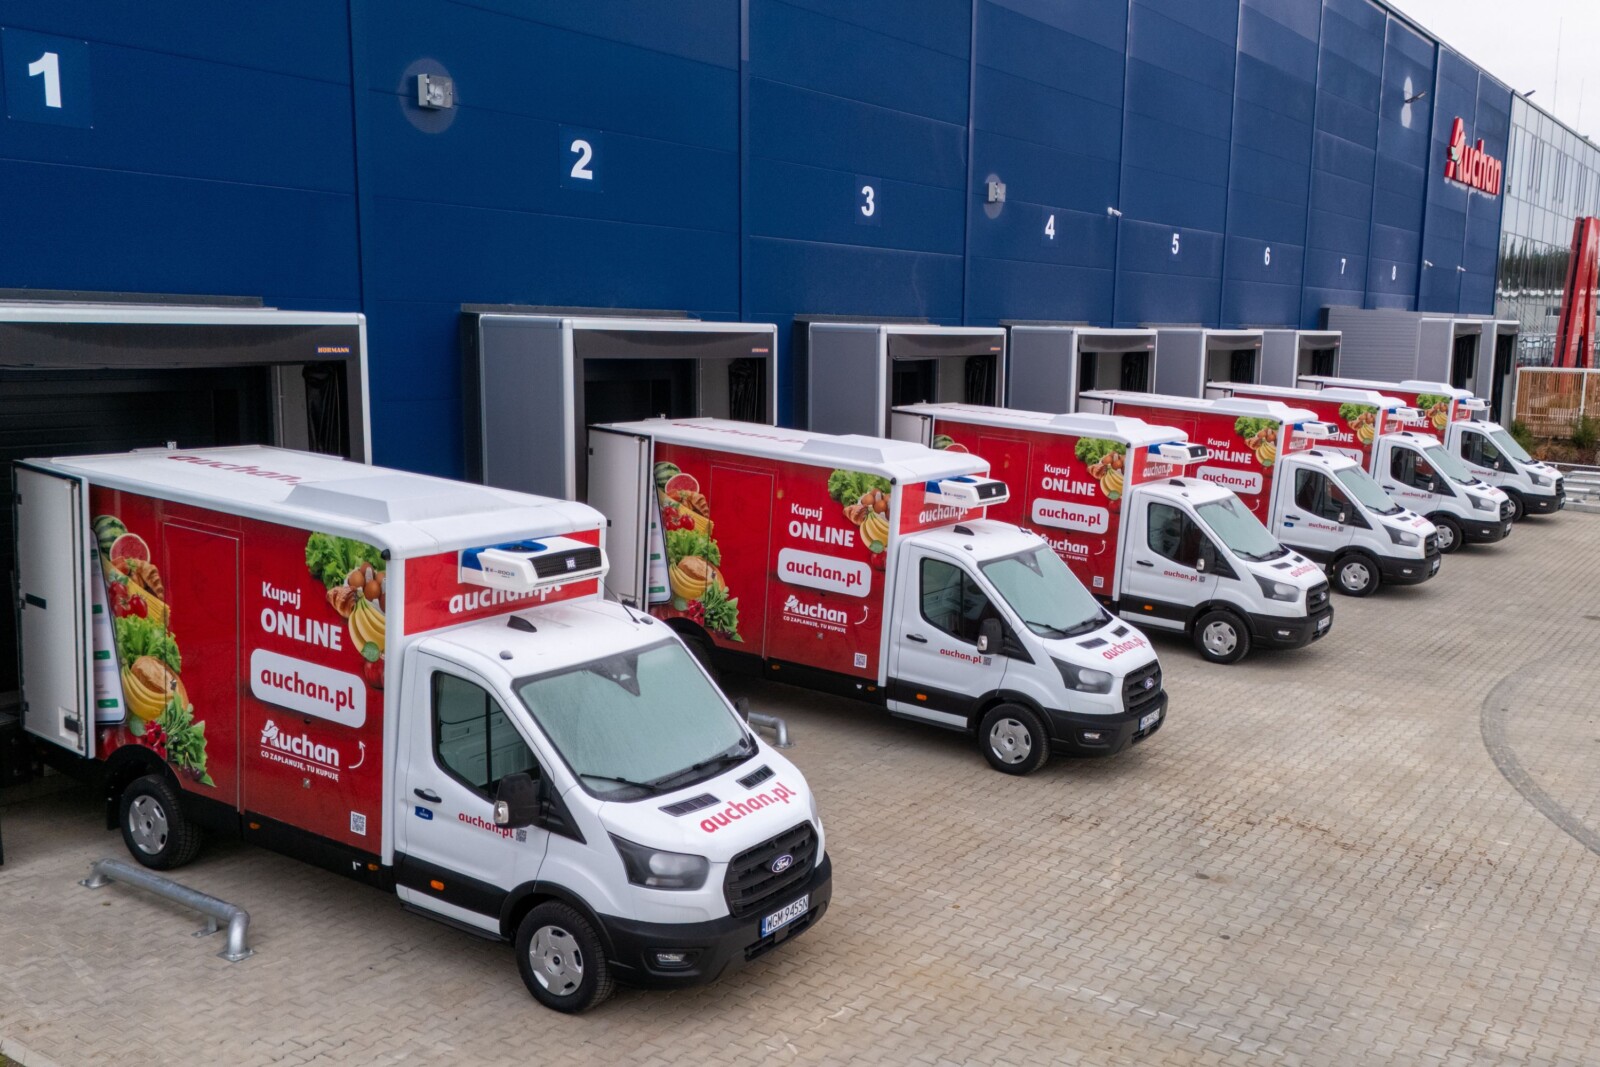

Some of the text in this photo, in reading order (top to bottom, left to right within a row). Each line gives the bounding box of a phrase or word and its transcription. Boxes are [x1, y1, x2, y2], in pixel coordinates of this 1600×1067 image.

[29, 52, 62, 108] 1
[570, 139, 593, 180] 2
[1444, 116, 1501, 195] Auchan
[861, 185, 875, 217] 3
[1045, 214, 1055, 240] 4
[1172, 233, 1180, 255] 5
[1264, 246, 1271, 266] 6
[1341, 258, 1346, 275] 7
[1207, 437, 1230, 449] Kupuj
[1207, 448, 1253, 464] ONLINE
[1043, 463, 1070, 477] Kupuj
[1202, 473, 1256, 488] auchan.pl
[1041, 477, 1096, 497] ONLINE
[791, 502, 823, 521] Kupuj
[1039, 508, 1101, 526] auchan.pl
[788, 520, 855, 547] ONLINE
[786, 561, 862, 587] auchan.pl
[262, 581, 301, 610] Kupuj
[783, 594, 848, 624] Auchan
[261, 607, 343, 652] ONLINE
[940, 648, 982, 664] auchan.pl
[261, 669, 355, 712] auchan.pl
[261, 719, 340, 767] Auchan
[261, 750, 270, 758] CO
[306, 764, 315, 773] TU
[700, 781, 797, 834] auchan.pl
[458, 812, 514, 839] auchan.pl
